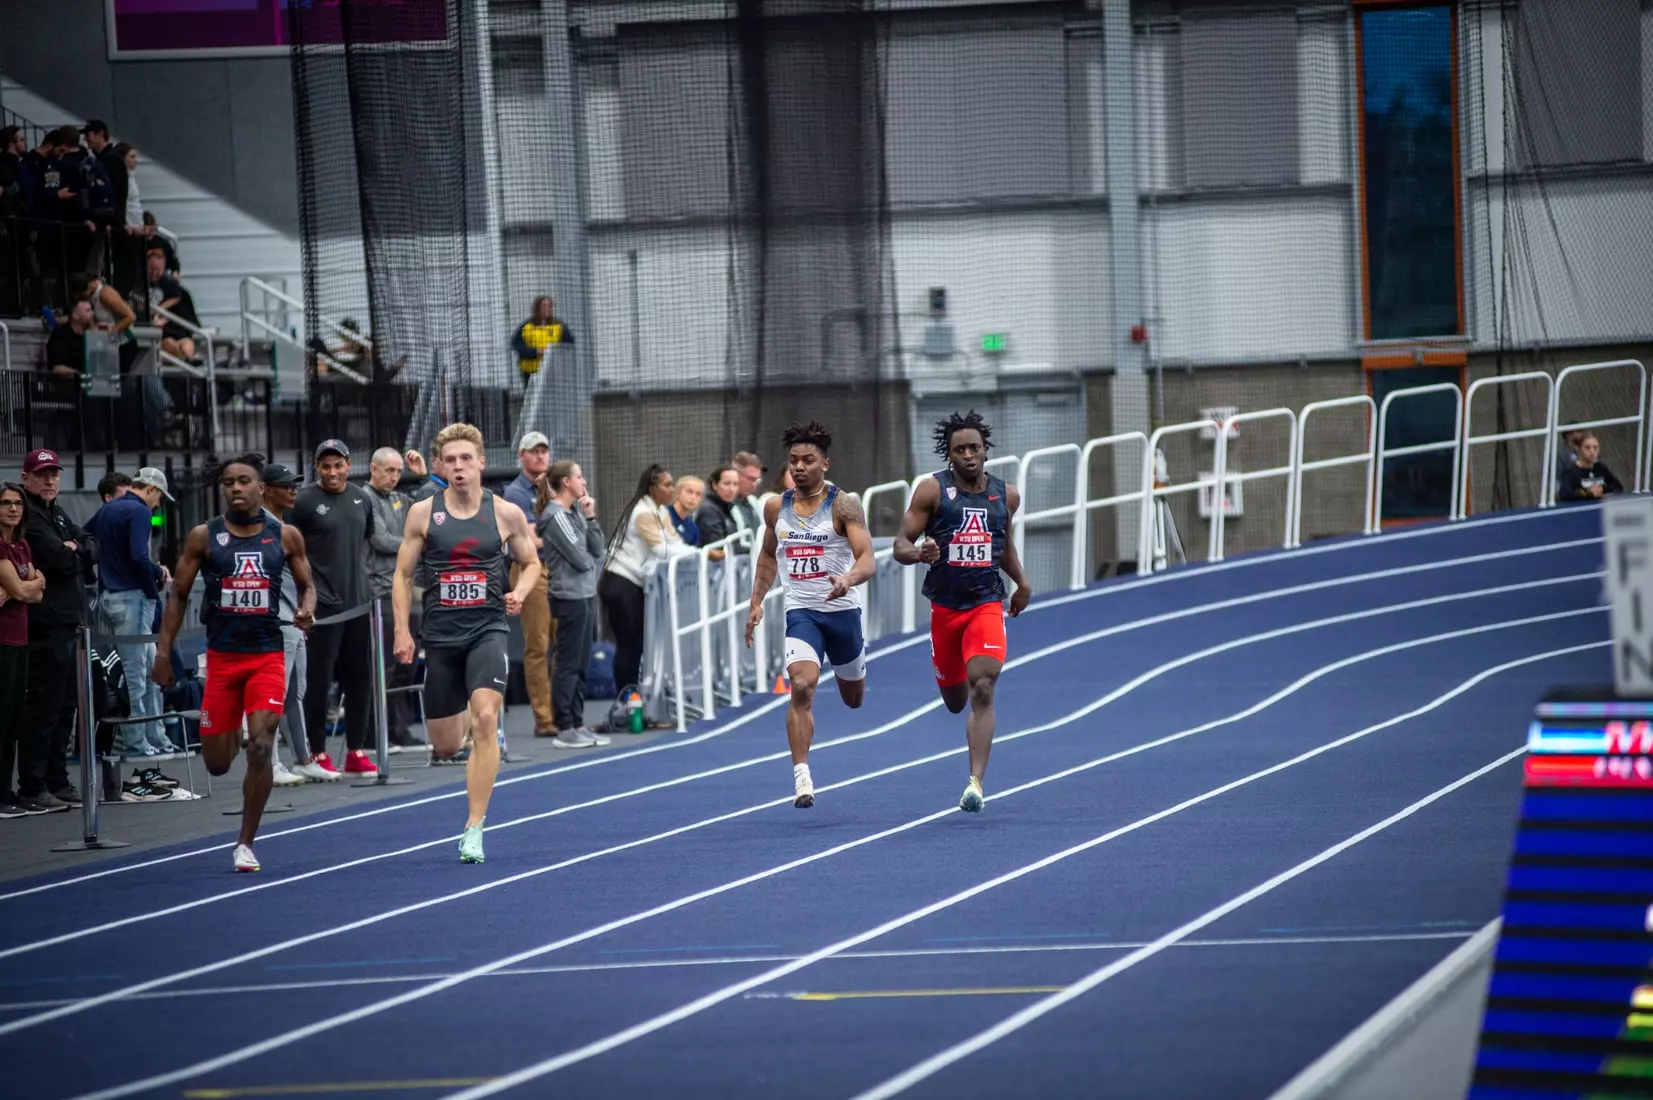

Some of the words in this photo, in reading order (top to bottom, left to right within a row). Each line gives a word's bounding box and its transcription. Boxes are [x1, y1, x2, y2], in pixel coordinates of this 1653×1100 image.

[957, 545, 986, 561] 145
[792, 557, 820, 574] 778
[463, 574, 477, 582] OPEN
[230, 590, 262, 607] 140
[448, 583, 479, 600] 885
